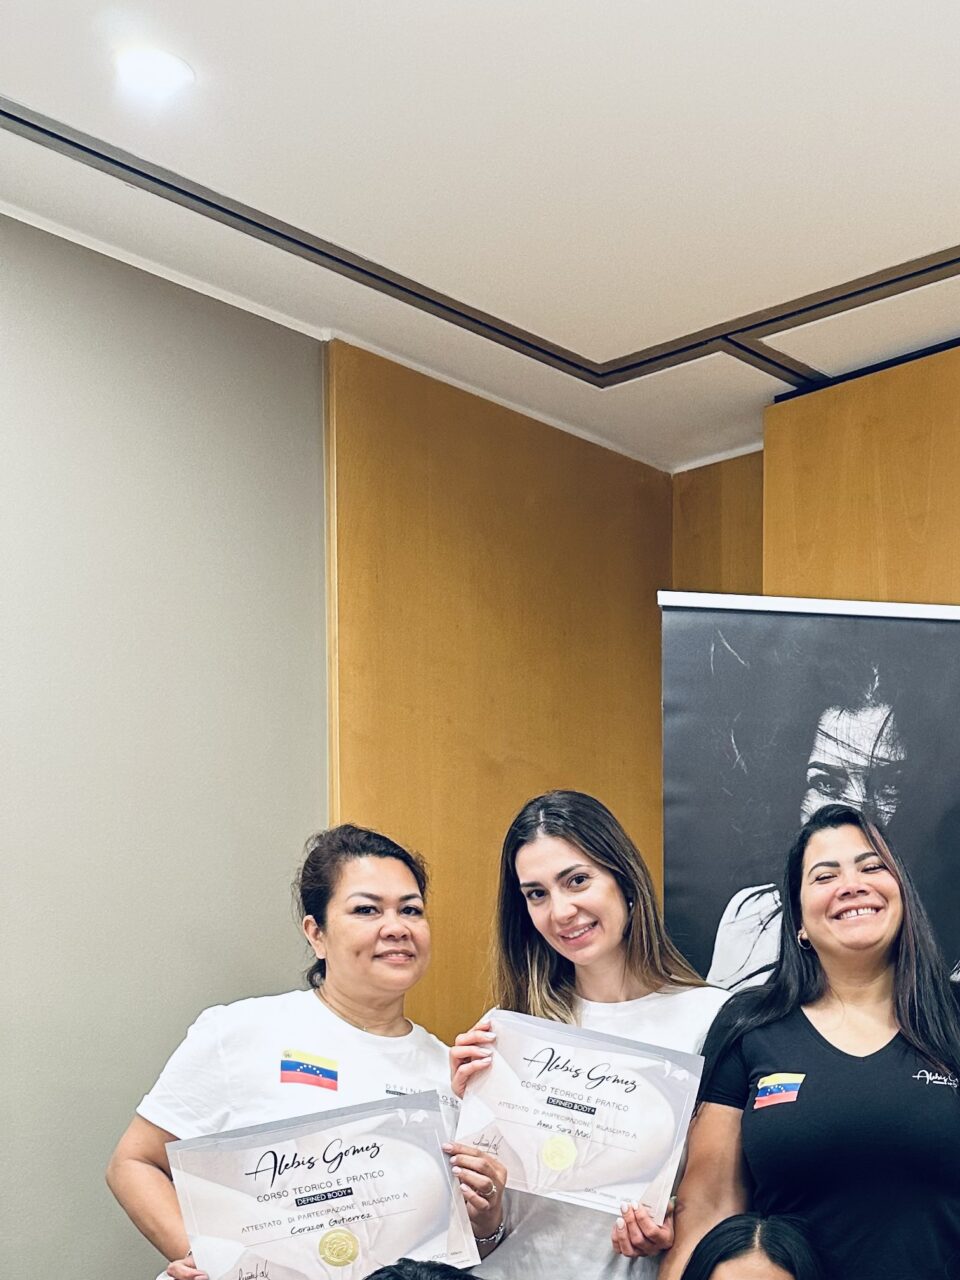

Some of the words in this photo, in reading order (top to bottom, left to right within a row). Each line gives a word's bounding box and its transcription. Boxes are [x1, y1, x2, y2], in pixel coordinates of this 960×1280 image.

[519, 1079, 548, 1093] CORSO
[549, 1086, 585, 1102] TEORICO
[586, 1095, 593, 1104] E
[594, 1097, 629, 1112] PRATICO
[244, 1150, 316, 1187] Alebis
[322, 1138, 380, 1174] Gomez
[256, 1189, 290, 1203] CORSO
[292, 1180, 334, 1196] TEORICO
[335, 1178, 344, 1186] E
[345, 1169, 385, 1184] PRATICO
[296, 1193, 327, 1206] DEFINED
[240, 1219, 283, 1234] ATTESTATO
[297, 1203, 357, 1222] PARTECIPAZIONE
[361, 1194, 401, 1208] RILASCIATO
